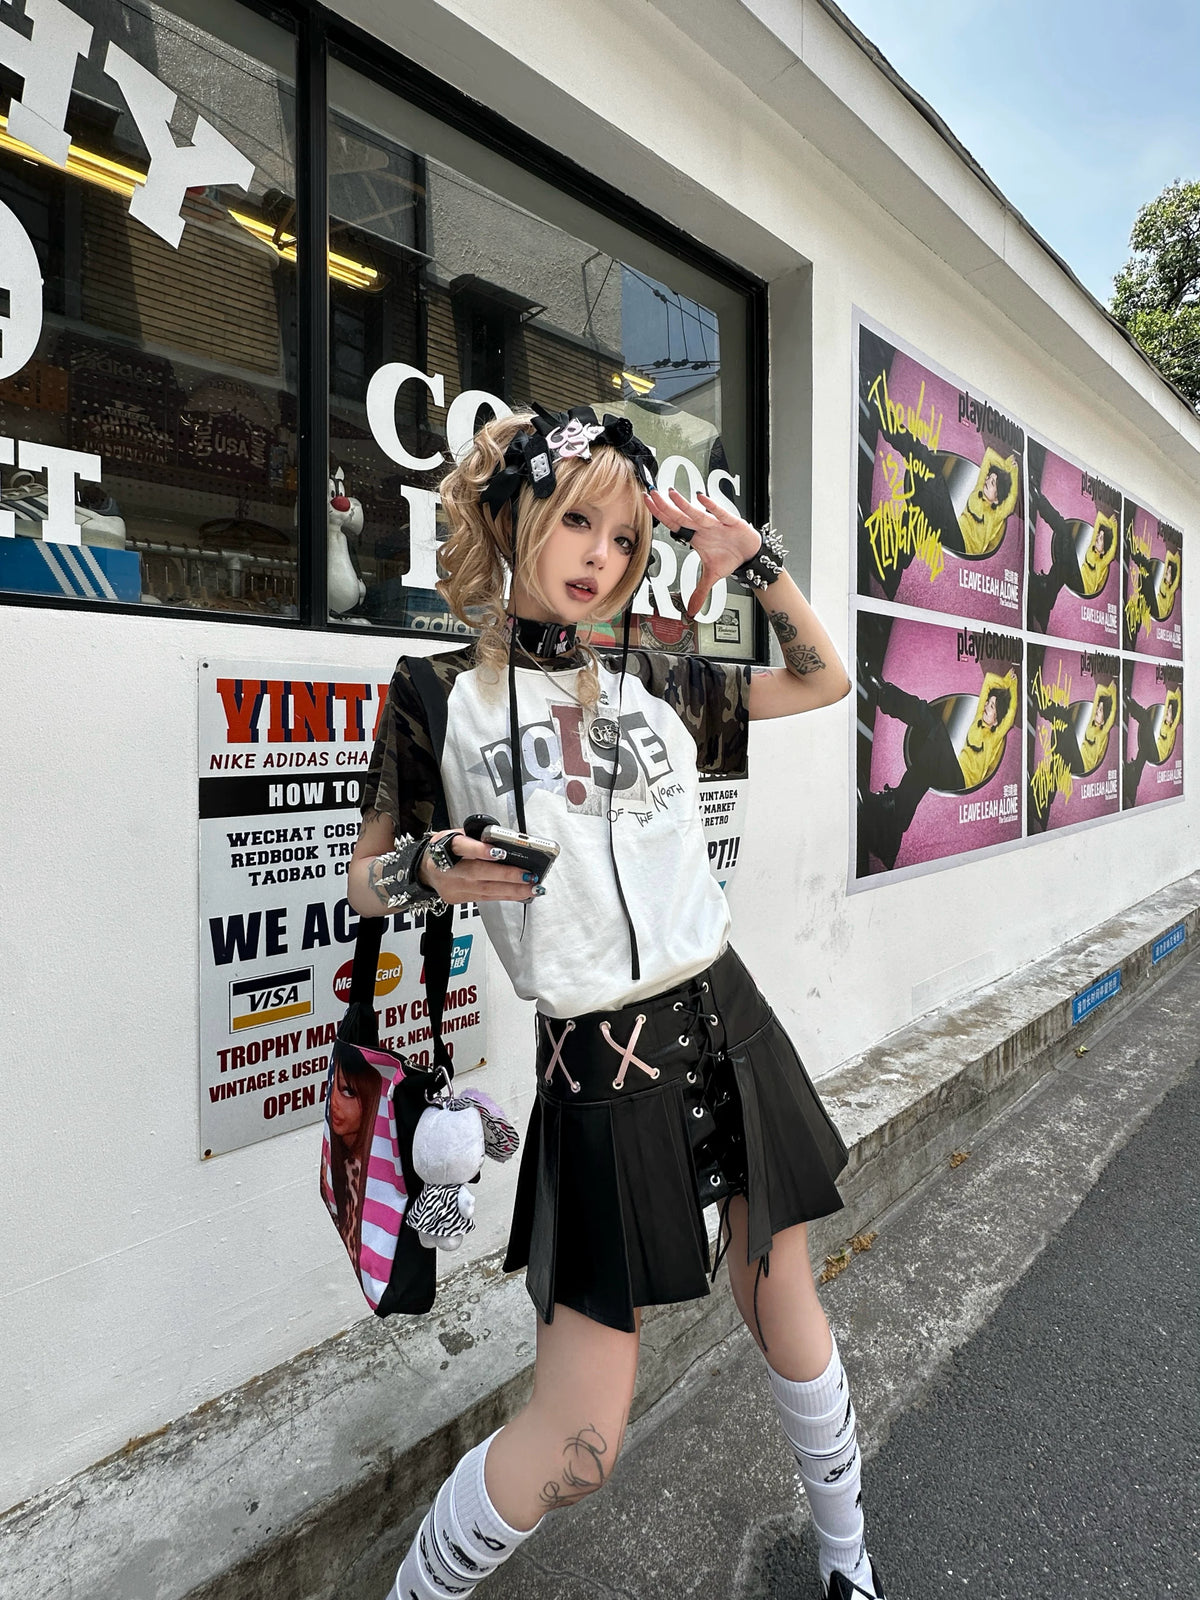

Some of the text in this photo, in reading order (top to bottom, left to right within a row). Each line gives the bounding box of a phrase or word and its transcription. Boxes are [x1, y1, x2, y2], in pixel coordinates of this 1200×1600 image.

[214, 432, 250, 459] USA
[879, 451, 898, 488] is
[959, 568, 1019, 602] LEAVE LEAH ALONE
[210, 753, 256, 770] NIKE
[263, 751, 329, 768] ADIDAS
[268, 780, 360, 807] HOW TO
[606, 783, 685, 827] OF THE NORTH
[699, 789, 738, 802] VINTAGE4
[704, 802, 736, 814] MARKET
[705, 815, 729, 827] RETRO
[959, 797, 1018, 823] LEAVE LEAH ALONE
[227, 826, 316, 847] WECHAT
[231, 846, 319, 868] REDBOOK
[248, 864, 326, 887] TAOBAO
[209, 907, 288, 966] WE
[247, 984, 299, 1012] VISA
[217, 1030, 302, 1073] TROPHY
[386, 1003, 408, 1028] BY
[410, 985, 477, 1020] COMOS
[209, 1070, 275, 1103] VINTAGE
[278, 1066, 290, 1083] &
[292, 1055, 328, 1078] USED
[396, 1036, 406, 1049] &
[408, 1022, 433, 1046] NEW
[263, 1085, 316, 1119] OPEN
